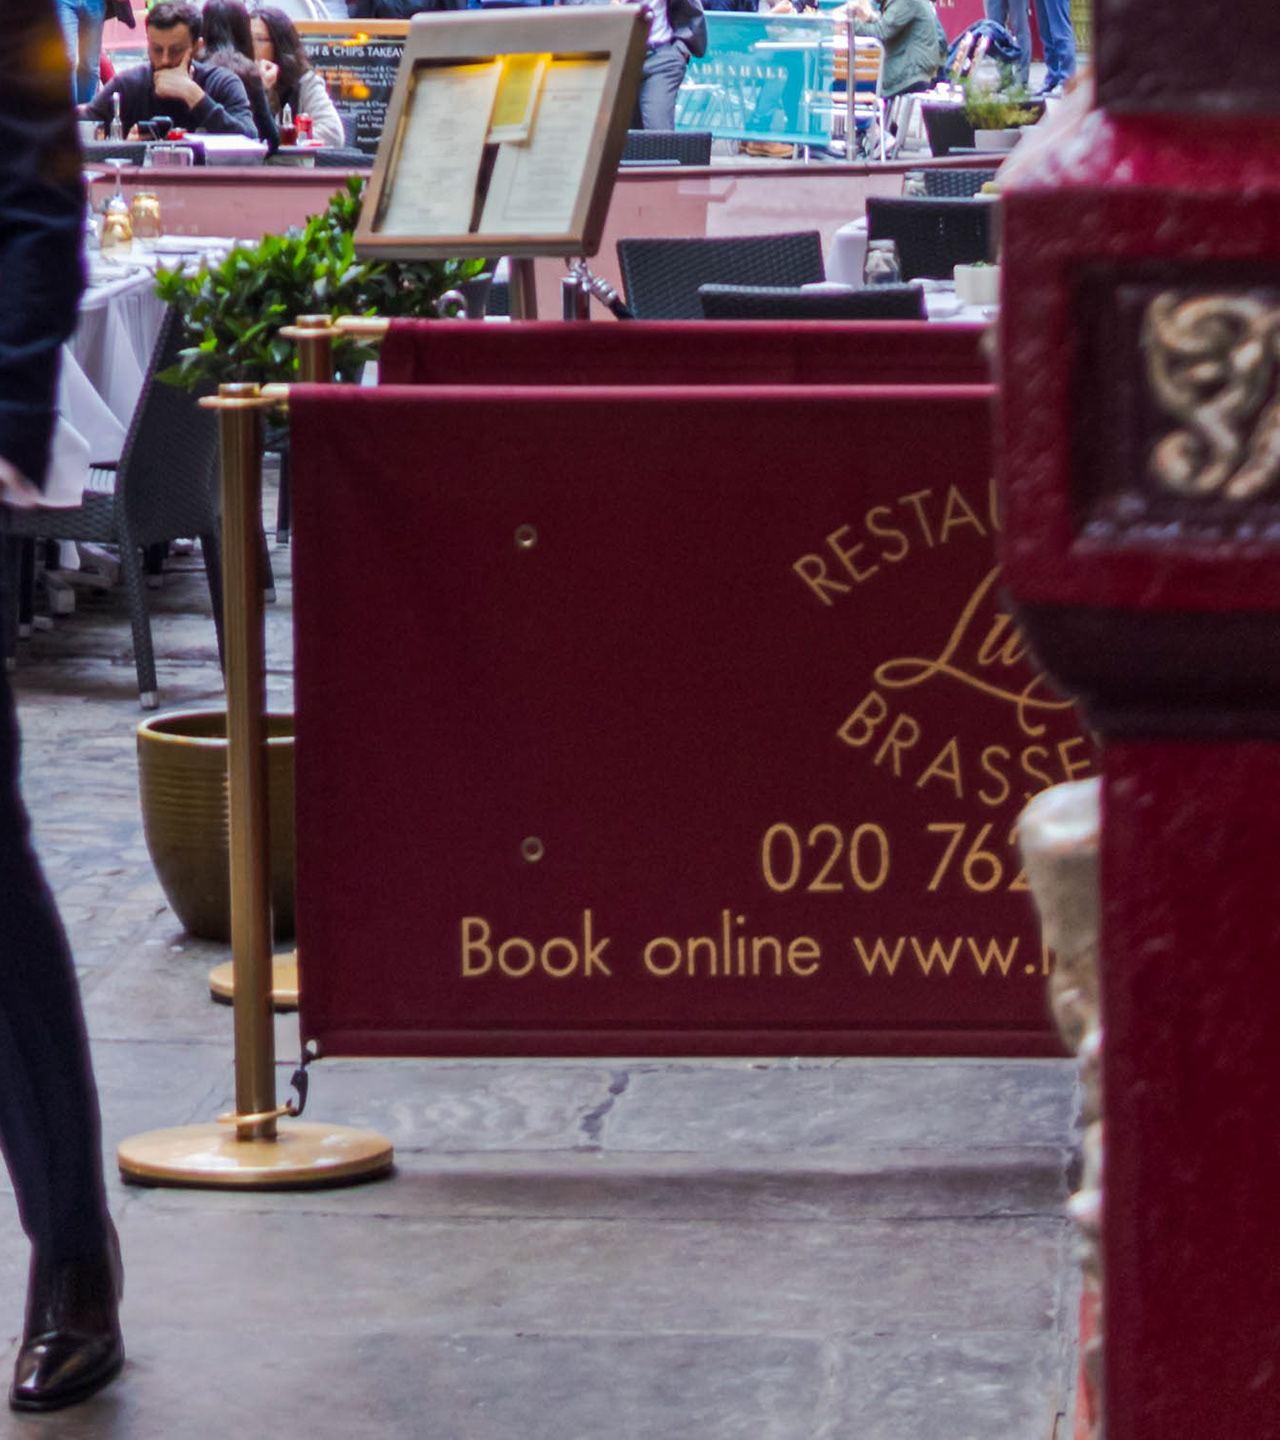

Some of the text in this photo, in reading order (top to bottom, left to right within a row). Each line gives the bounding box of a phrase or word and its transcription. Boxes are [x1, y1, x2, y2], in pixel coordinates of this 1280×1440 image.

[332, 44, 365, 58] CHIPS
[761, 822, 890, 893] 020
[461, 910, 612, 978] Book
[644, 912, 823, 978] online
